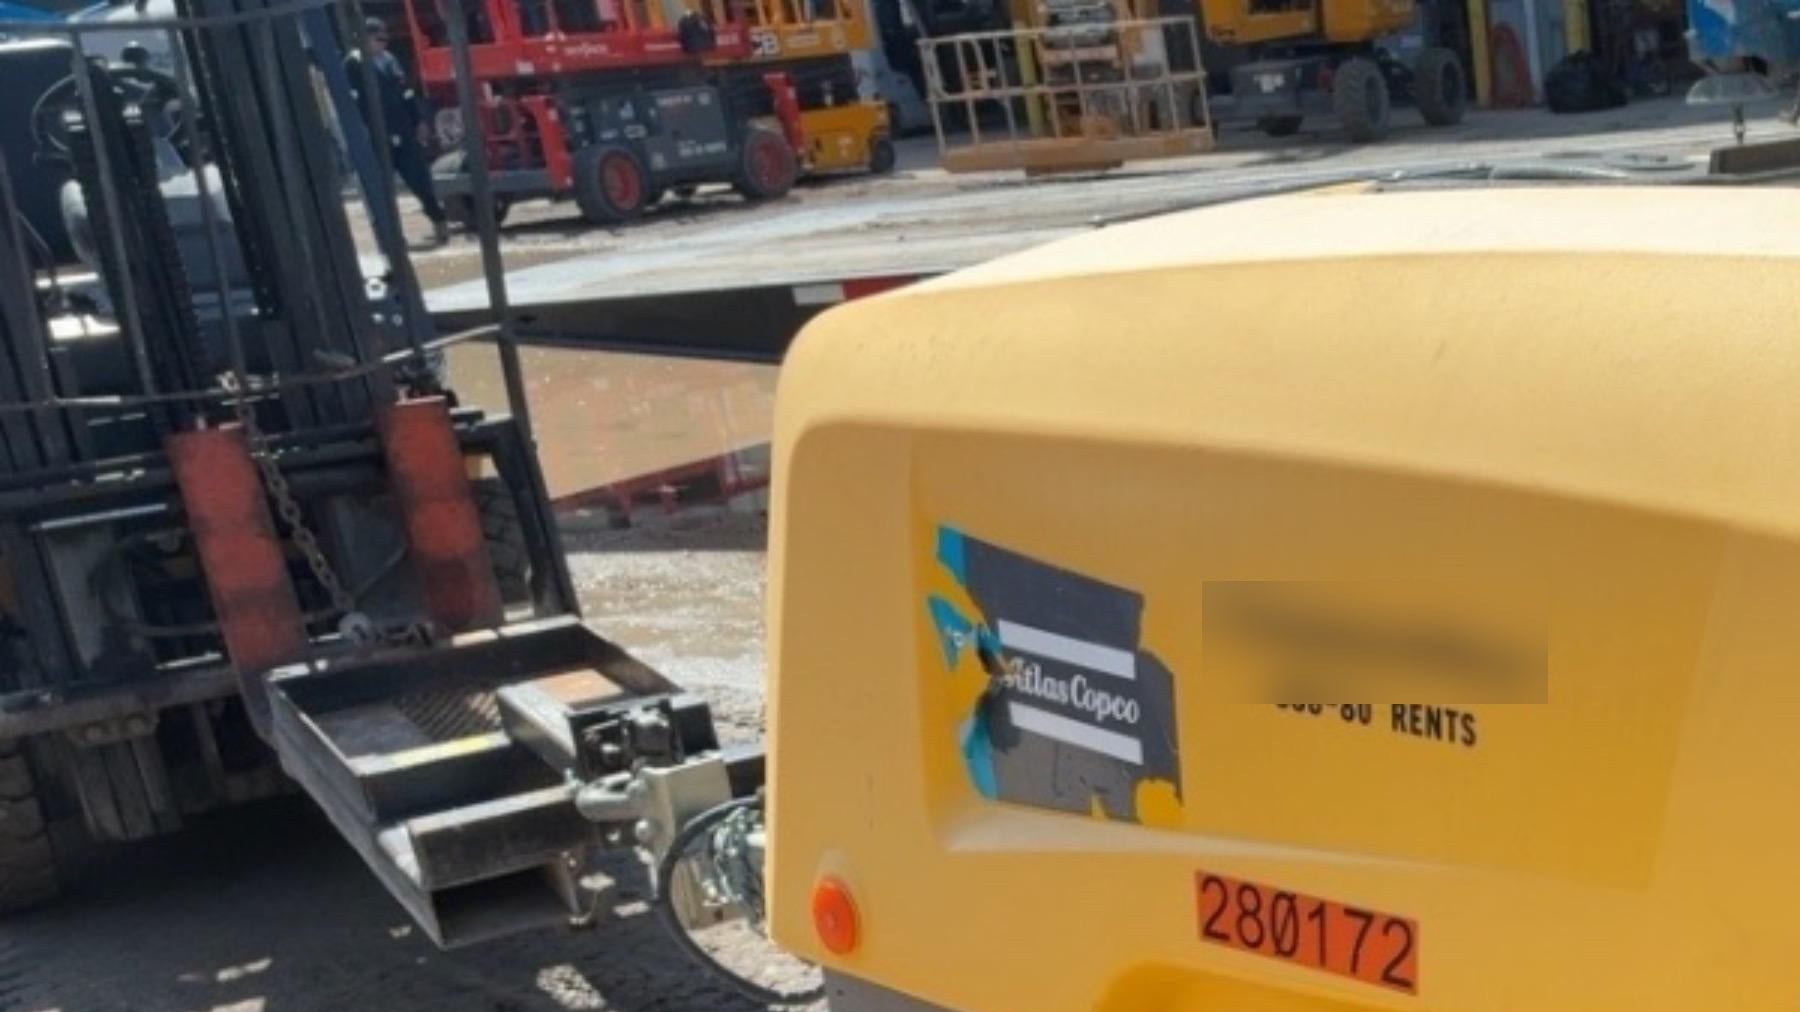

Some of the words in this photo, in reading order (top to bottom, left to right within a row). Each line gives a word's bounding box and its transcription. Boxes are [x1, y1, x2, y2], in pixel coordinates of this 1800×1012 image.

[1070, 674, 1139, 723] Copco
[1391, 704, 1477, 747] RENTS
[1201, 875, 1413, 987] 280172
